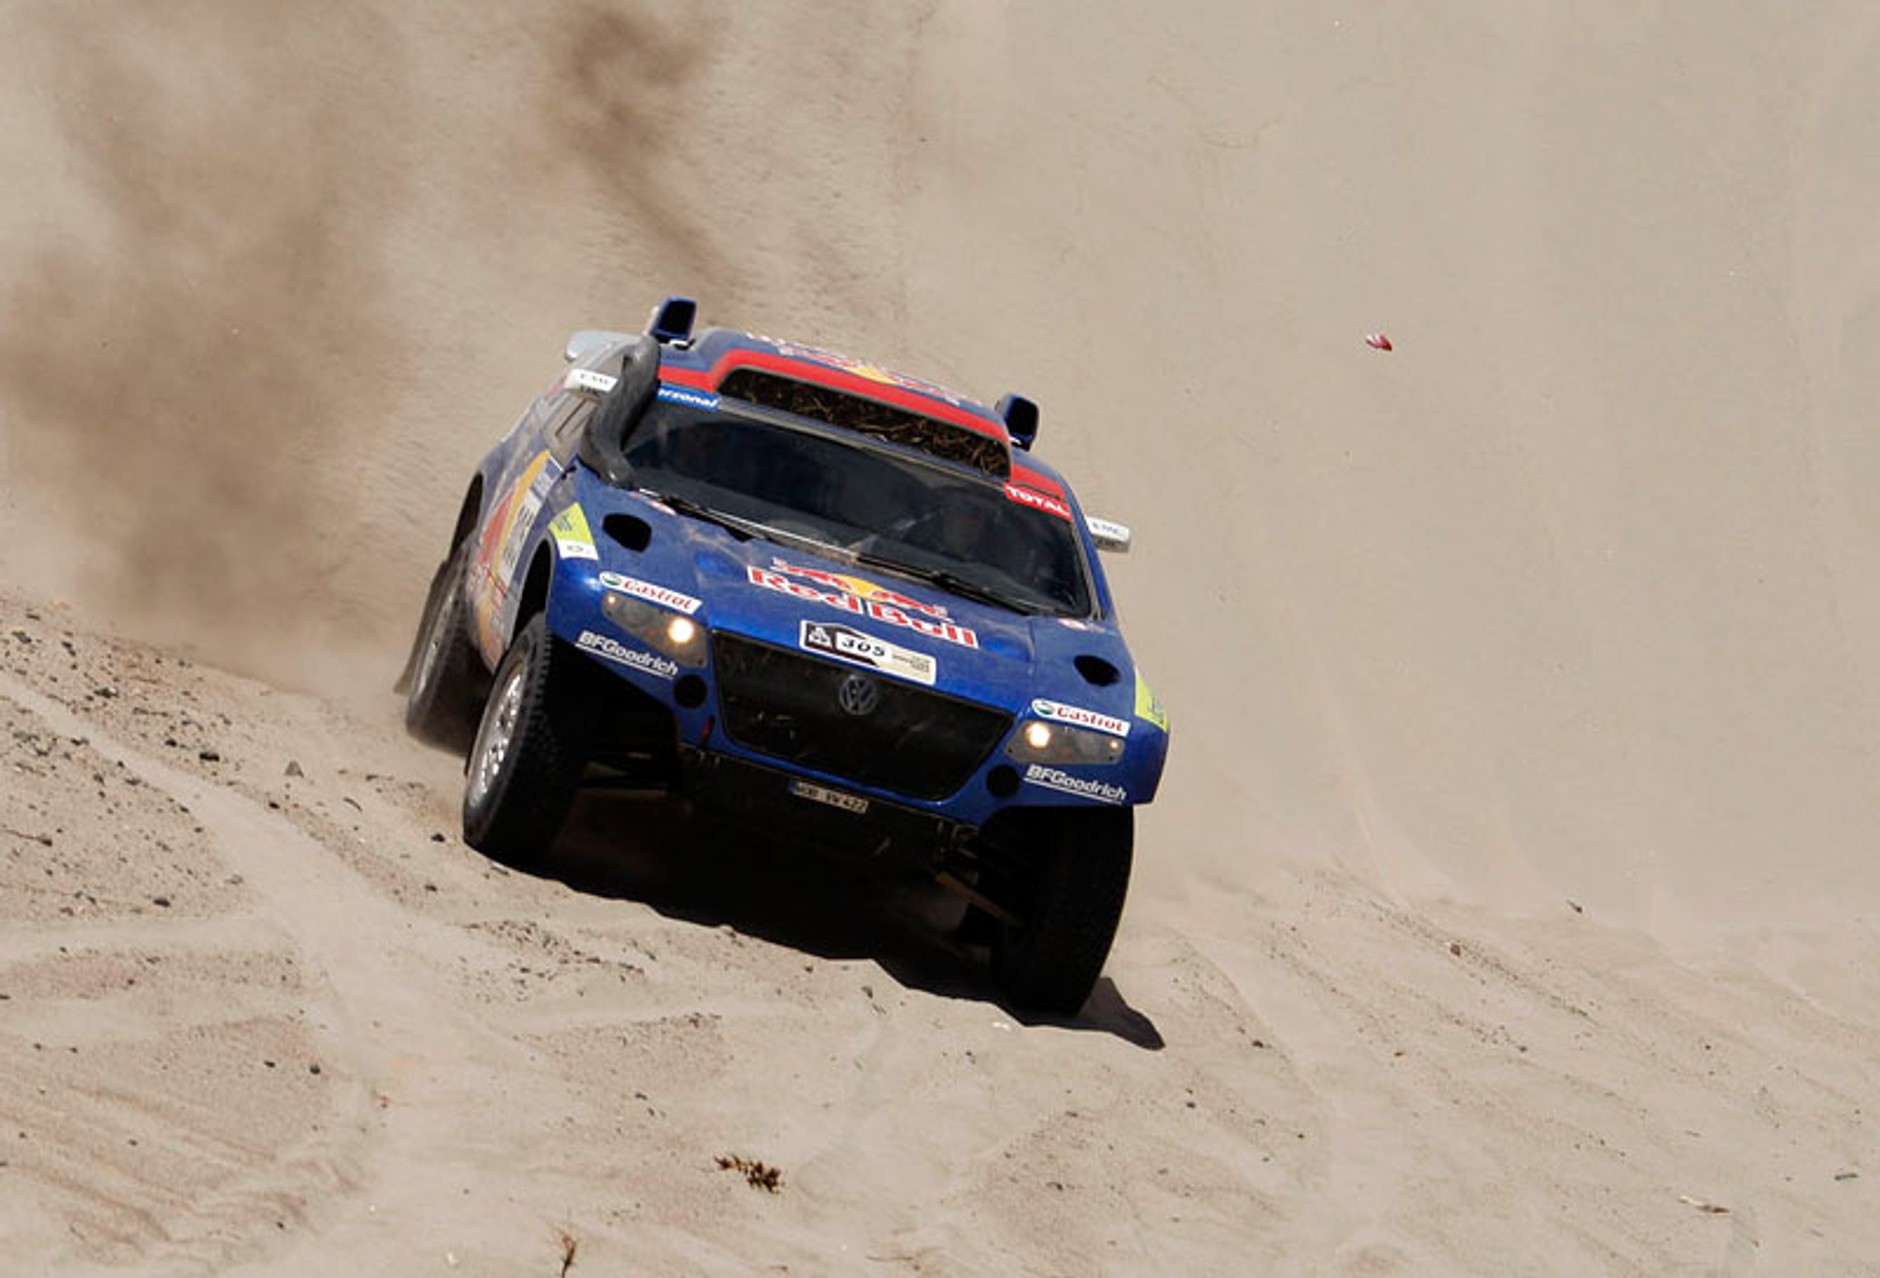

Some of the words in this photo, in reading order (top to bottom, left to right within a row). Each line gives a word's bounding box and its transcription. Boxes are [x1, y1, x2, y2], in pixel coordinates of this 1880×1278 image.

[1005, 485, 1071, 516] TOTAL
[623, 579, 693, 610] Castrol
[747, 565, 864, 615] Red
[866, 600, 979, 649] Bull
[578, 630, 679, 676] BFGoodrich
[841, 637, 885, 657] 305
[1056, 704, 1124, 732] Castrol
[1025, 763, 1127, 801] BFGoodrich
